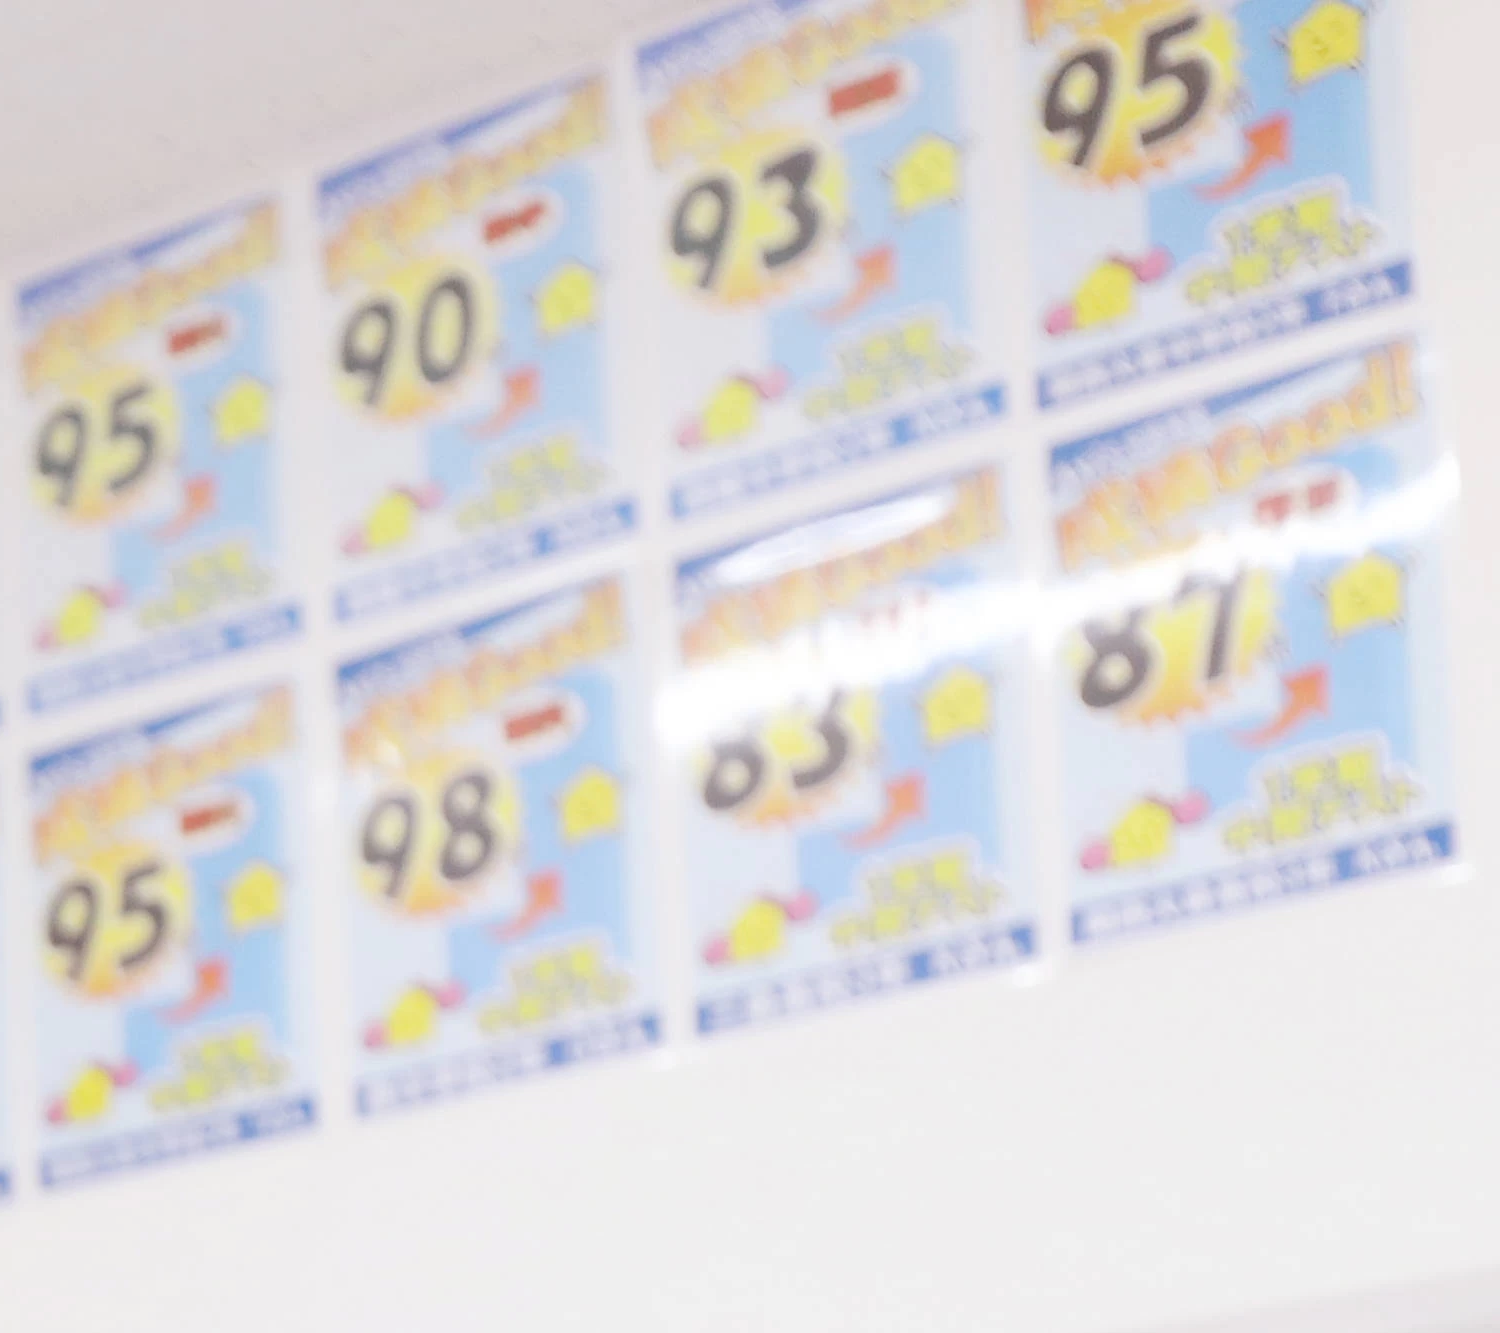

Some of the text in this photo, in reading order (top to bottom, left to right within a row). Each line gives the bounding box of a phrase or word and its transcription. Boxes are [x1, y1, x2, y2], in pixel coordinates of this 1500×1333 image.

[1043, 15, 1209, 166] 95
[668, 145, 820, 289] 93
[339, 274, 476, 406] 90
[32, 381, 158, 508] 95
[360, 770, 496, 898] 98
[45, 862, 169, 983] 95
